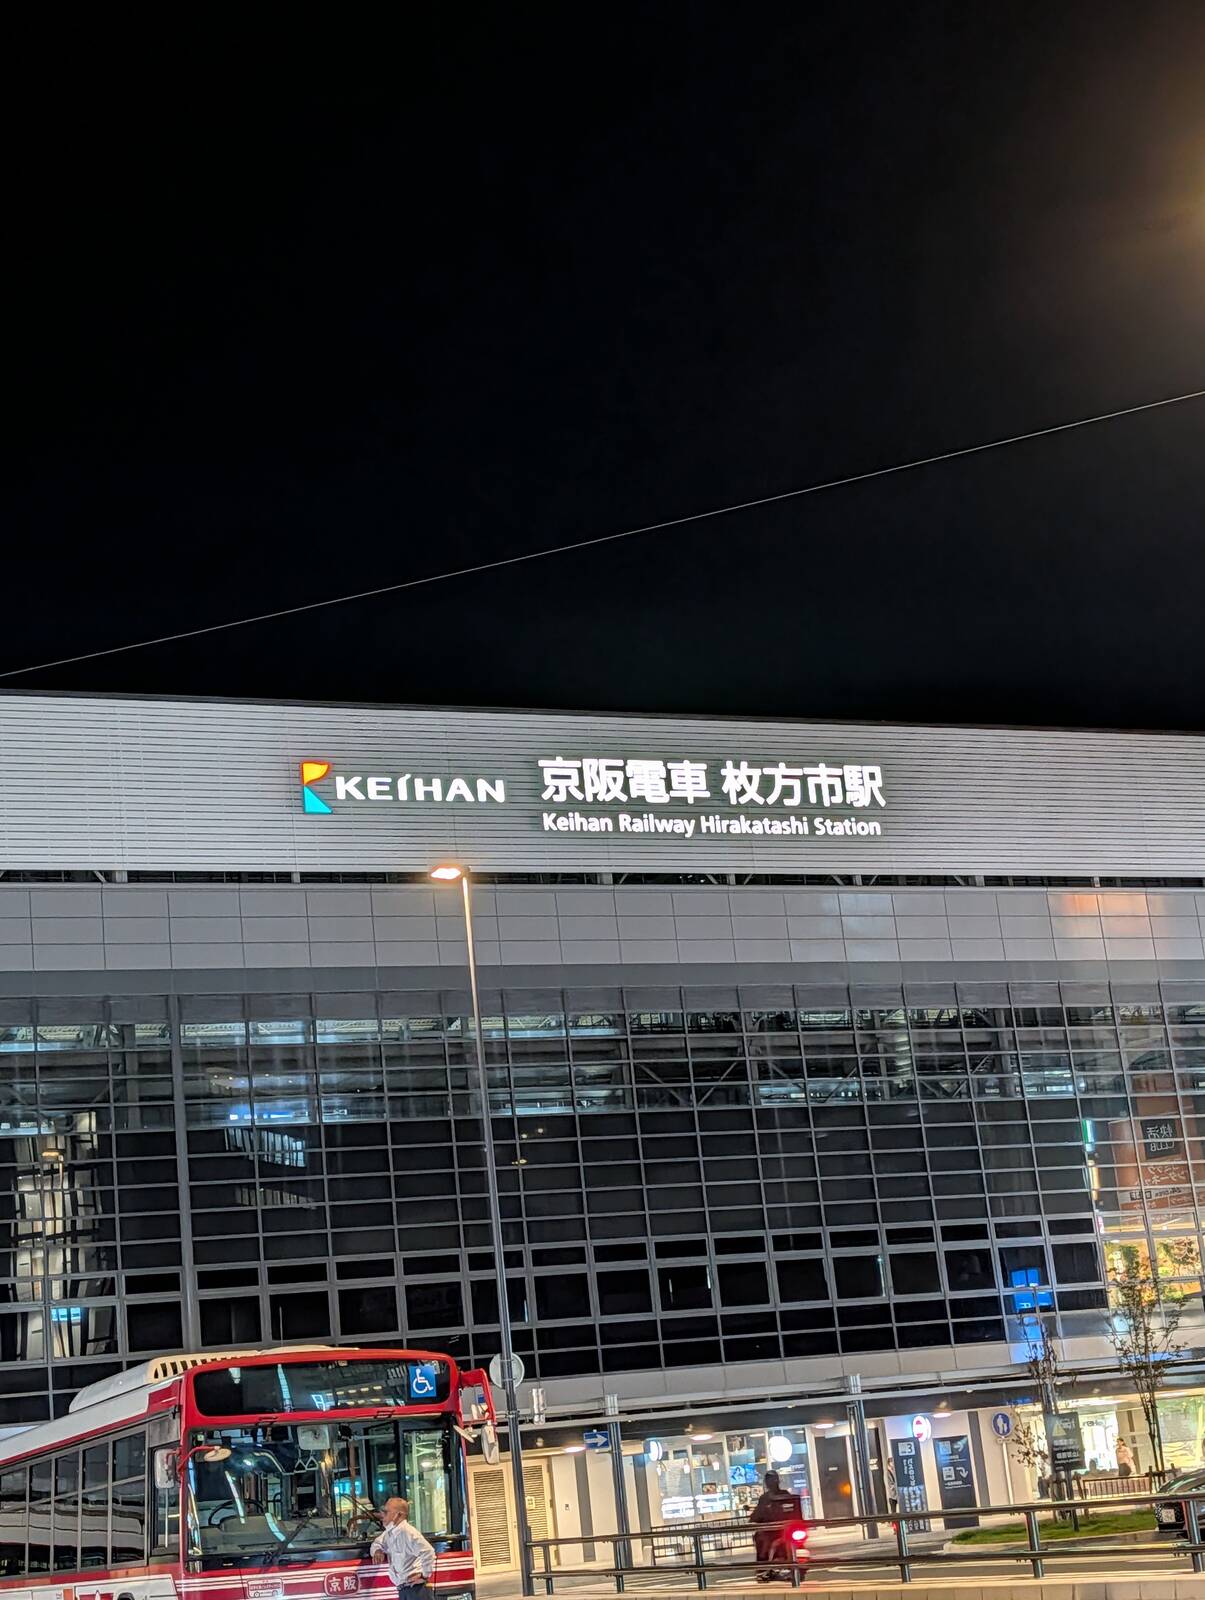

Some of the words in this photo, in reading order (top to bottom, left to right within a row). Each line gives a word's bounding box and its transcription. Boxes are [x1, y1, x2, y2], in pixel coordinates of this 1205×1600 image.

[335, 774, 506, 803] KEIHAN
[538, 756, 711, 804] 京阪電車
[720, 761, 887, 808] 枚方市駅
[542, 812, 613, 832] Keihan
[618, 813, 696, 838] Railway
[700, 815, 809, 835] Hirakatashi
[813, 817, 882, 836] Station
[329, 1576, 357, 1593] 京阪
